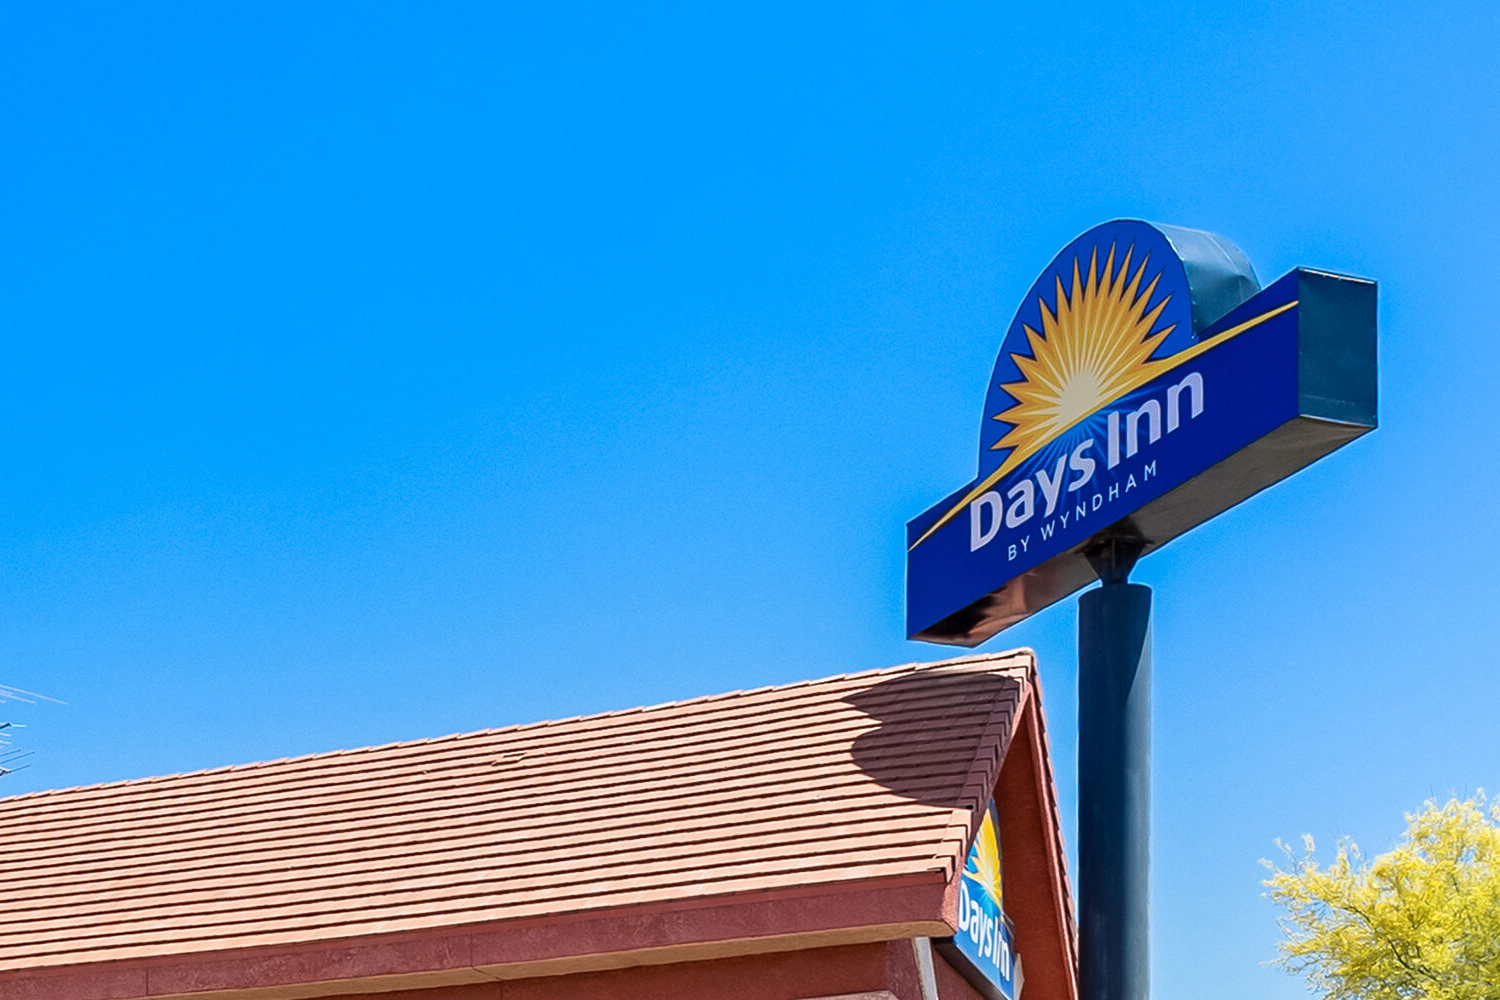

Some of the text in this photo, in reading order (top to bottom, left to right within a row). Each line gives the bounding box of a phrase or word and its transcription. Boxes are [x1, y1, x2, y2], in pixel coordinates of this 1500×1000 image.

[970, 371, 1204, 553] Days Inn
[1008, 459, 1157, 561] BY WYNDHAM
[958, 879, 1011, 982] Days Inn
